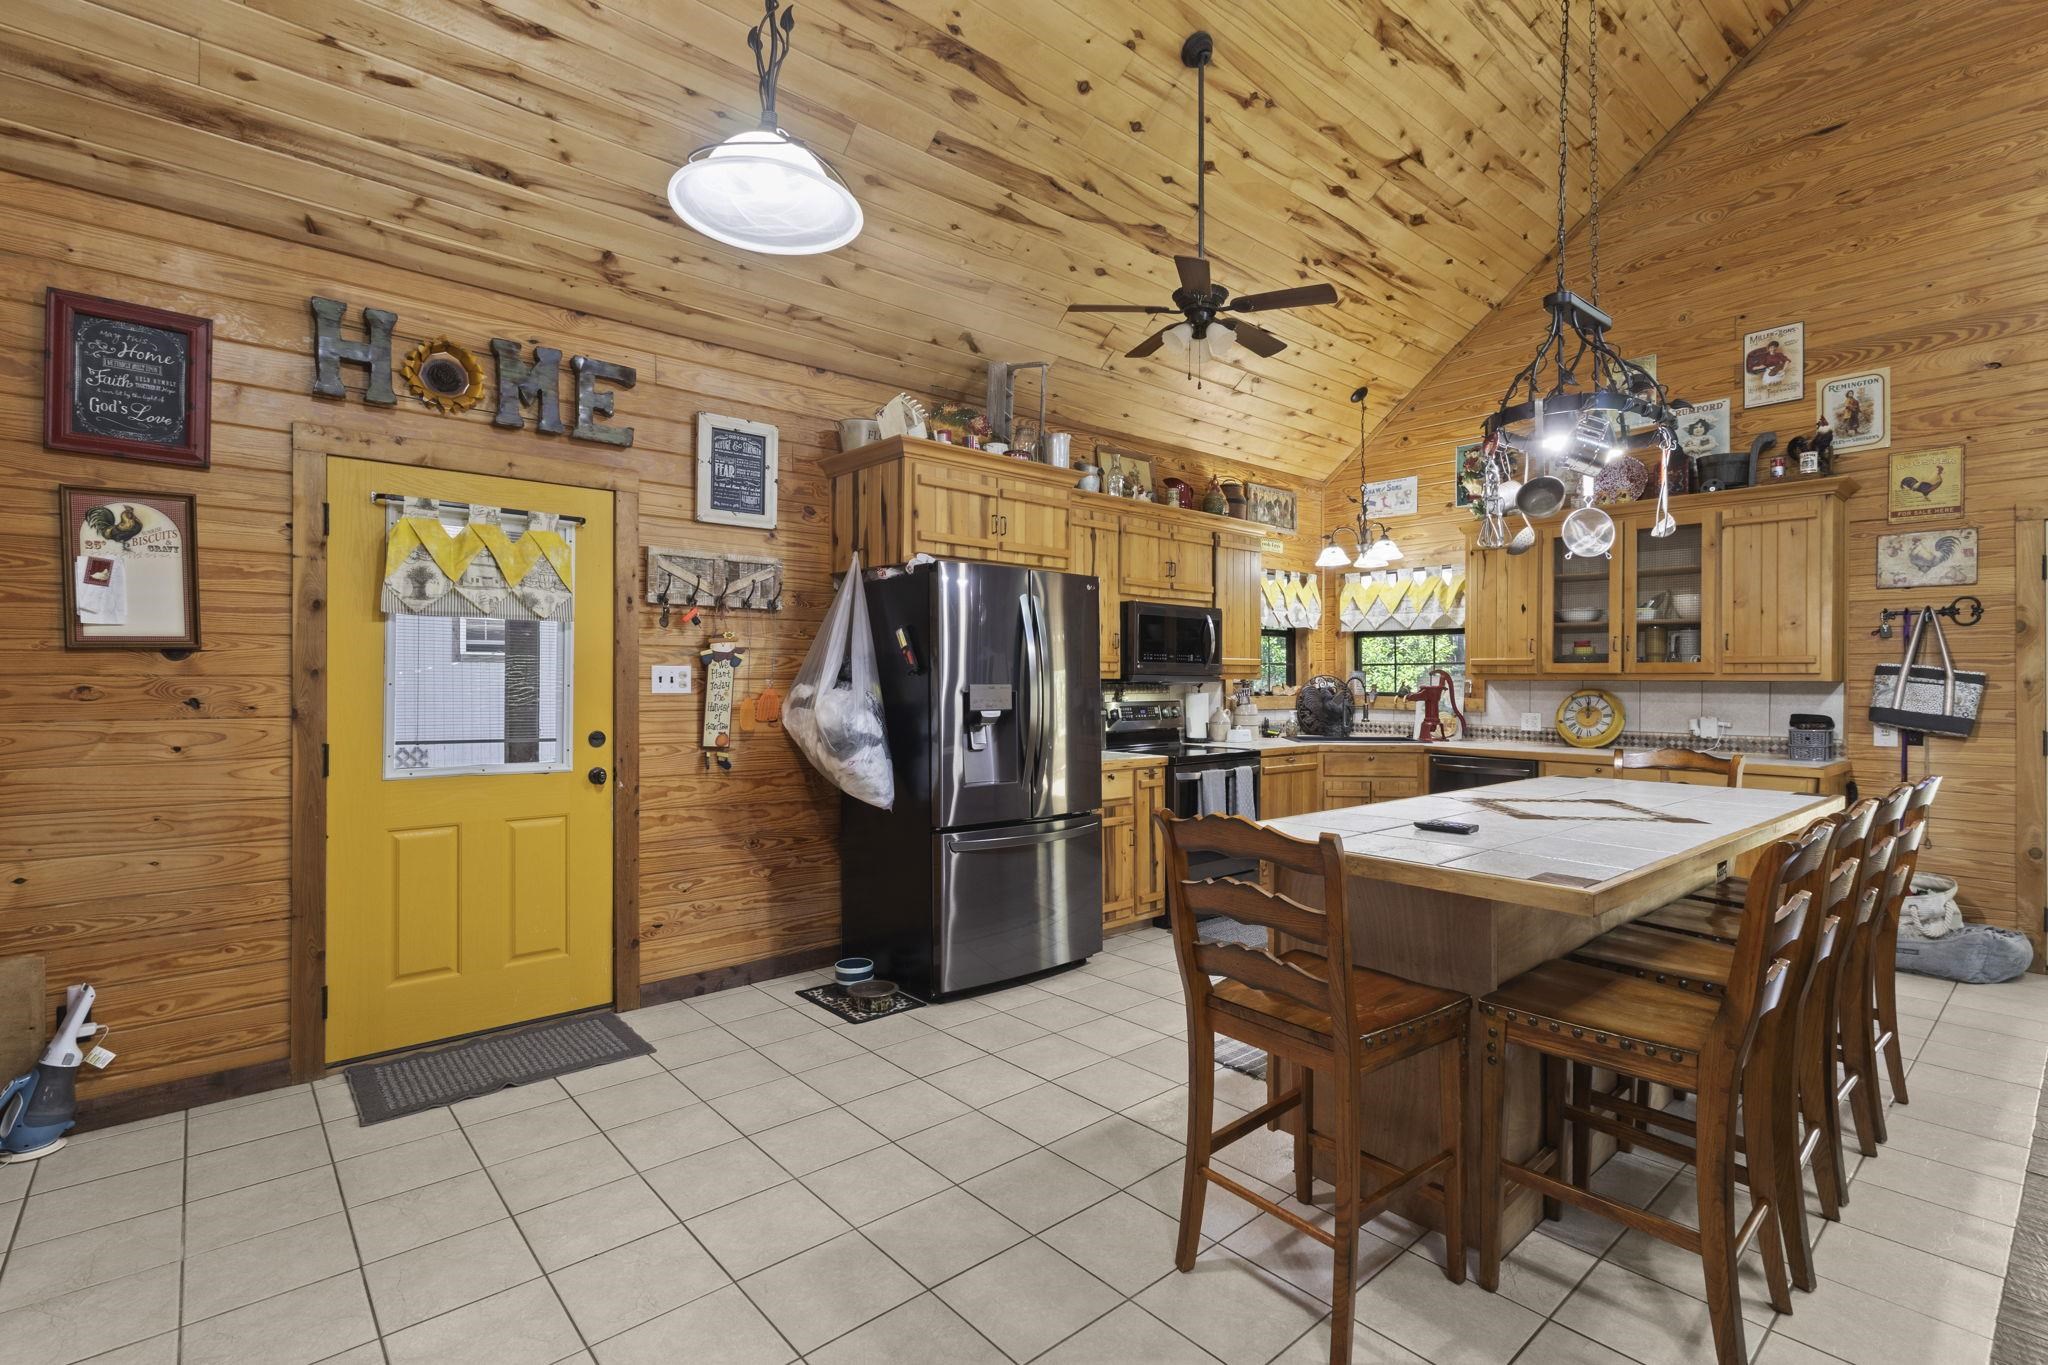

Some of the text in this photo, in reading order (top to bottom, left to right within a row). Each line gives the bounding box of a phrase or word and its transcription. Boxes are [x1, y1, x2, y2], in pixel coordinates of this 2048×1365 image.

[117, 341, 175, 365] Home
[86, 367, 134, 388] Faith
[1828, 377, 1880, 392] REMINGTON
[89, 396, 172, 425] God's Love
[1675, 402, 1724, 416] RUMFORD
[732, 440, 742, 451] &
[715, 463, 735, 478] FEAR
[132, 529, 178, 547] BISCUITS
[147, 544, 179, 554] GRAVY
[719, 660, 729, 669] We
[711, 668, 731, 680] Plant
[710, 680, 731, 691] Today
[714, 711, 722, 723] of
